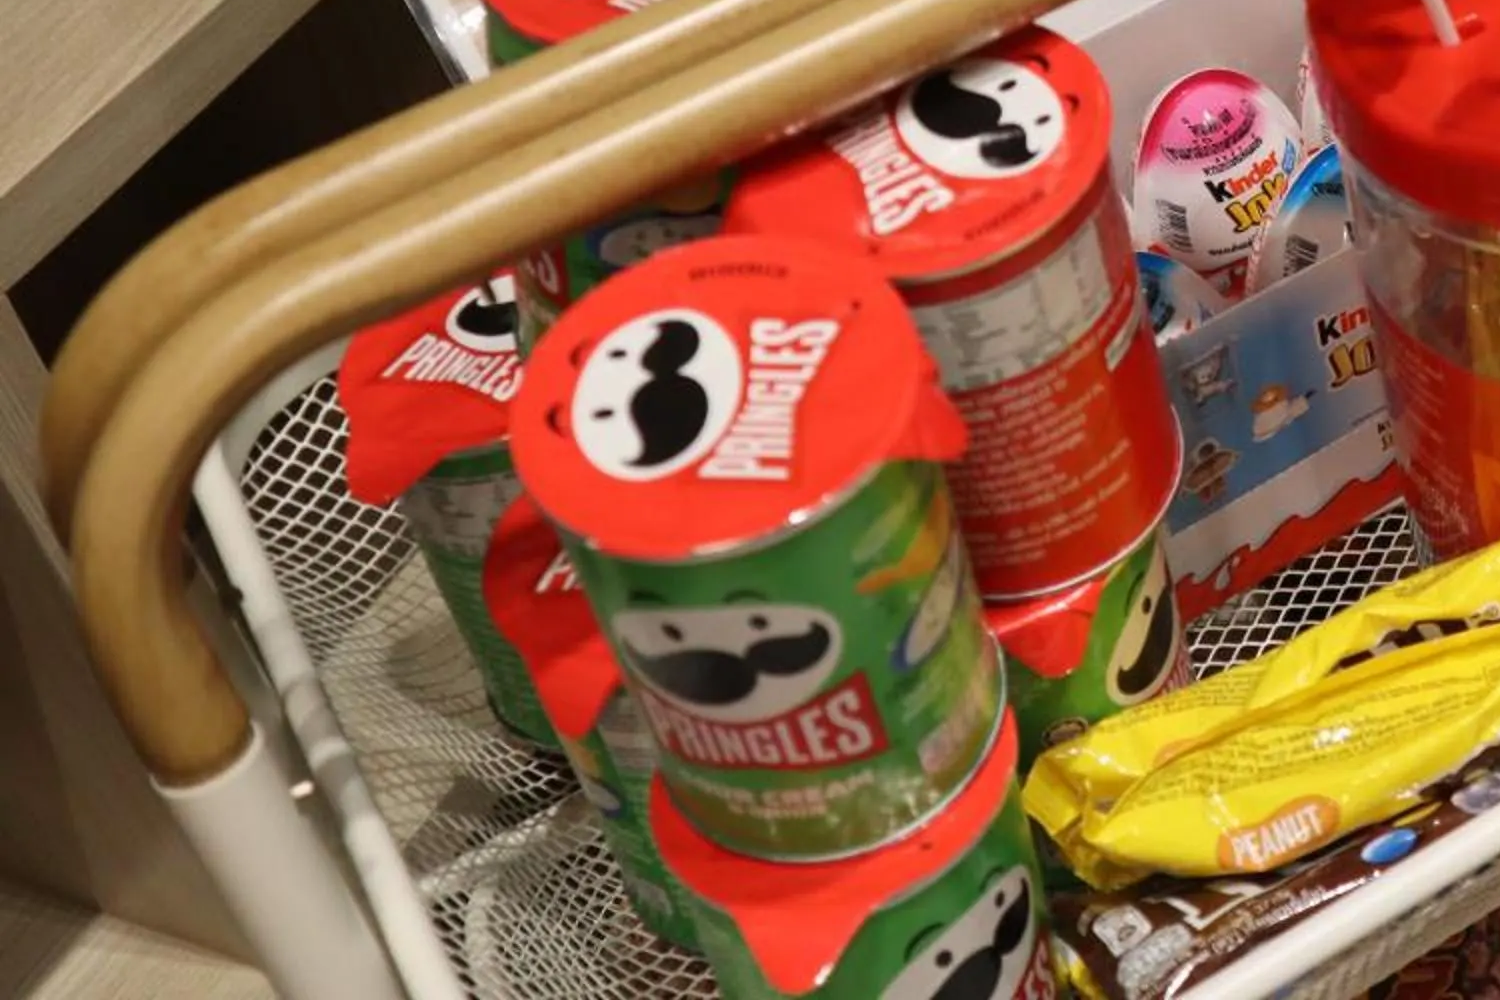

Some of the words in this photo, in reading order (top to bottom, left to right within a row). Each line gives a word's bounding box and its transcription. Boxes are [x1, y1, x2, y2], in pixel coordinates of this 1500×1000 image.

[1204, 151, 1279, 204] Kinder
[1317, 306, 1370, 347] Kin
[381, 332, 523, 403] PRINGLES
[698, 317, 841, 481] PRINGLES
[1328, 338, 1377, 389] Jo
[641, 687, 874, 766] PRINGLES
[1230, 803, 1323, 874] PEANUT
